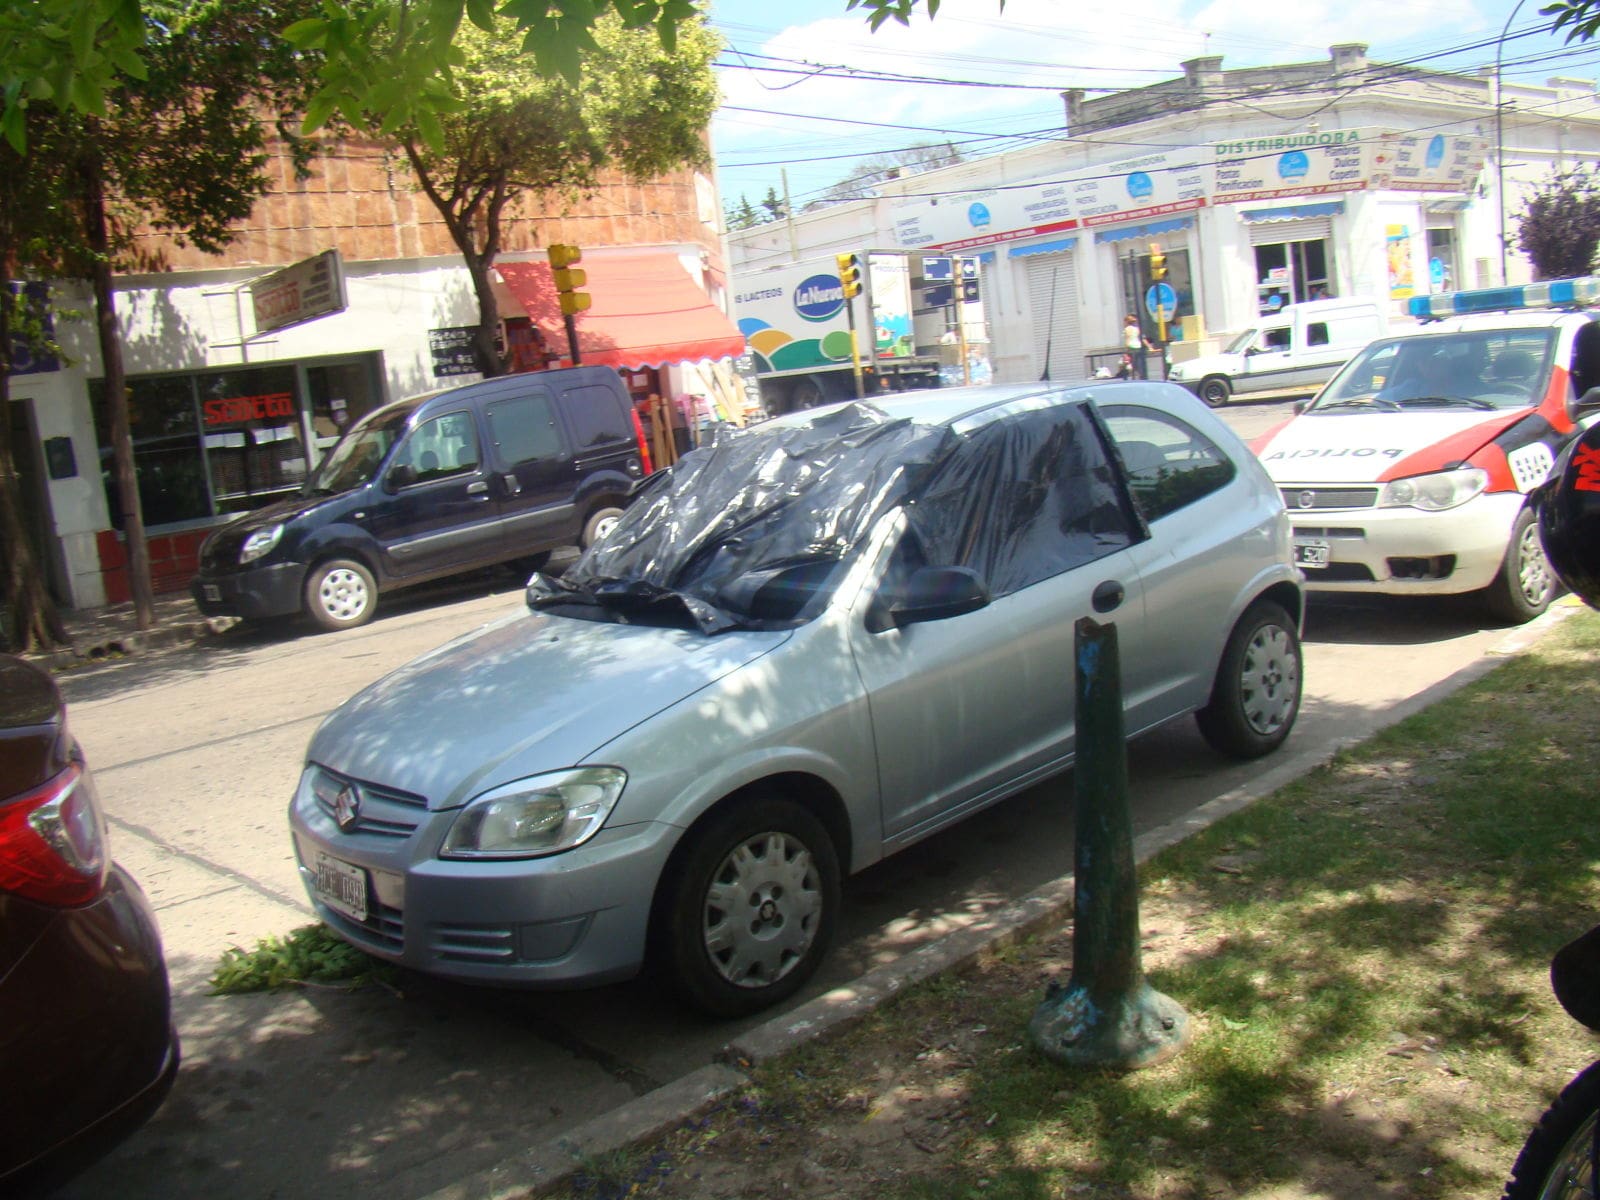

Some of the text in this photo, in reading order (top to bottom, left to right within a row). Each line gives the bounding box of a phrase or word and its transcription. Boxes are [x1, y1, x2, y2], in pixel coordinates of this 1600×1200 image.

[1216, 131, 1360, 155] DISTRIBUIDORA
[1334, 158, 1360, 168] Dulces
[1216, 169, 1240, 180] Pastas
[745, 287, 783, 301] LACTEOS
[796, 288, 809, 307] La
